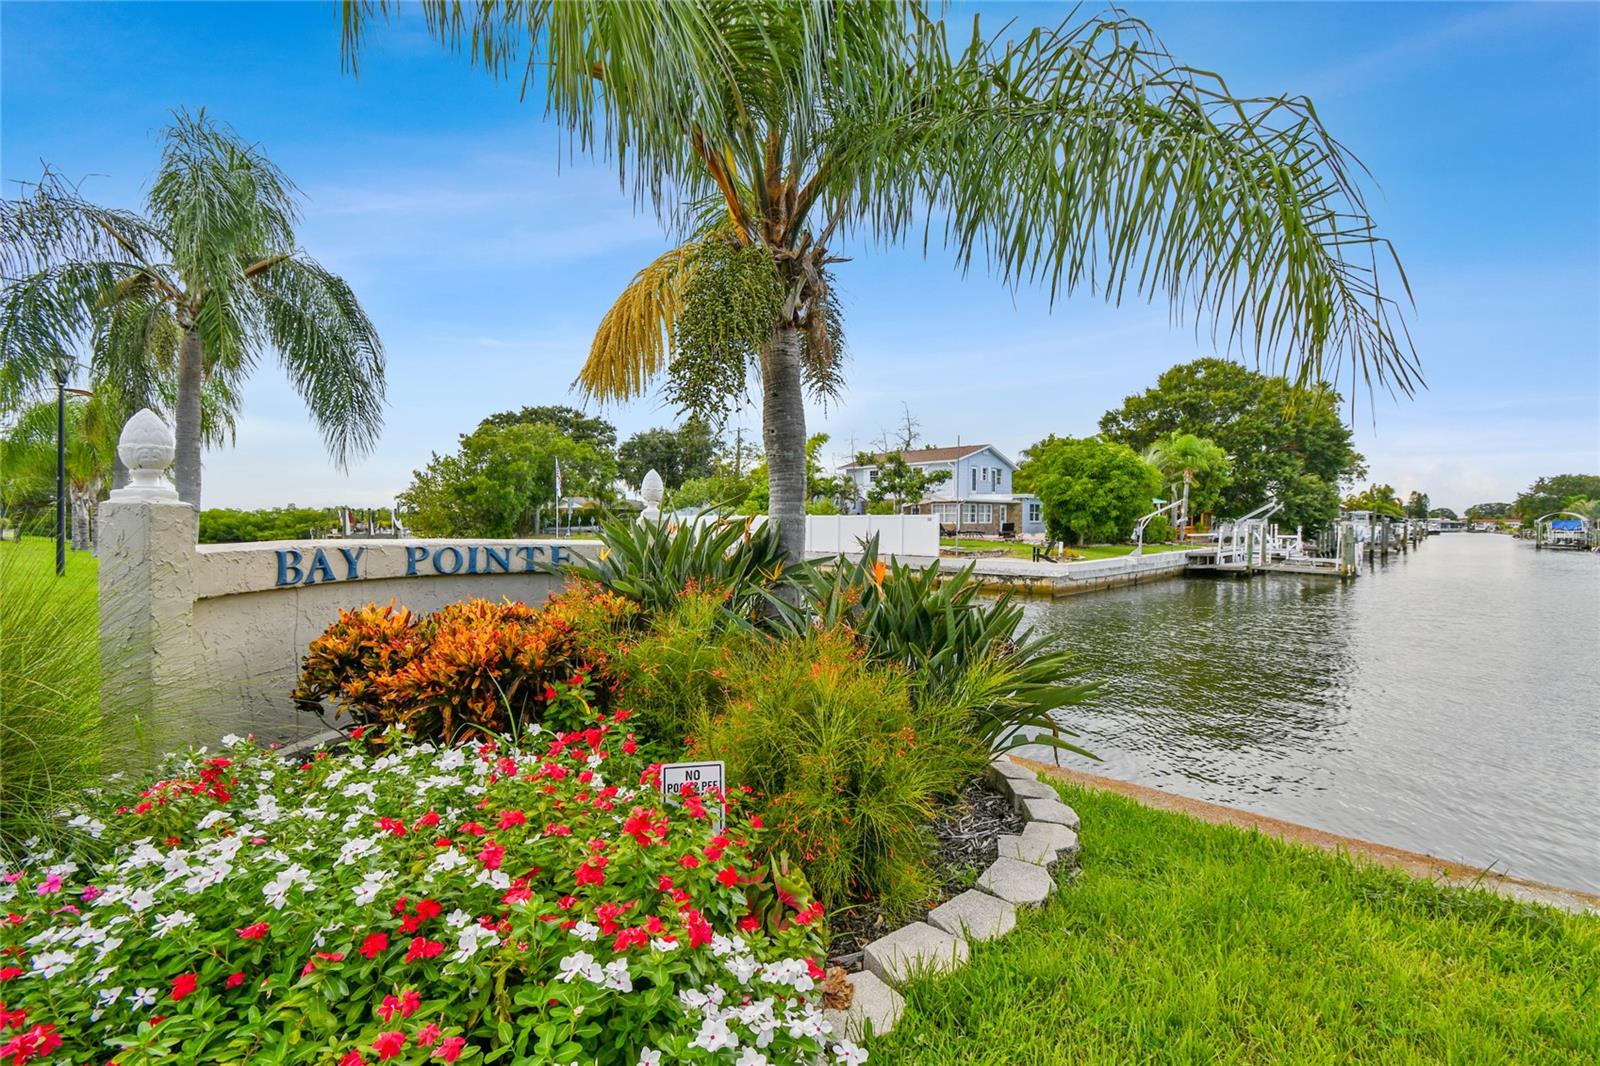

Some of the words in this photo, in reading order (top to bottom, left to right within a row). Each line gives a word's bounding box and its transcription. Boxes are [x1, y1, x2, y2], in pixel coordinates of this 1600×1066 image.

[275, 546, 364, 586] BAY
[406, 544, 574, 576] POINTE
[685, 770, 701, 781] NO
